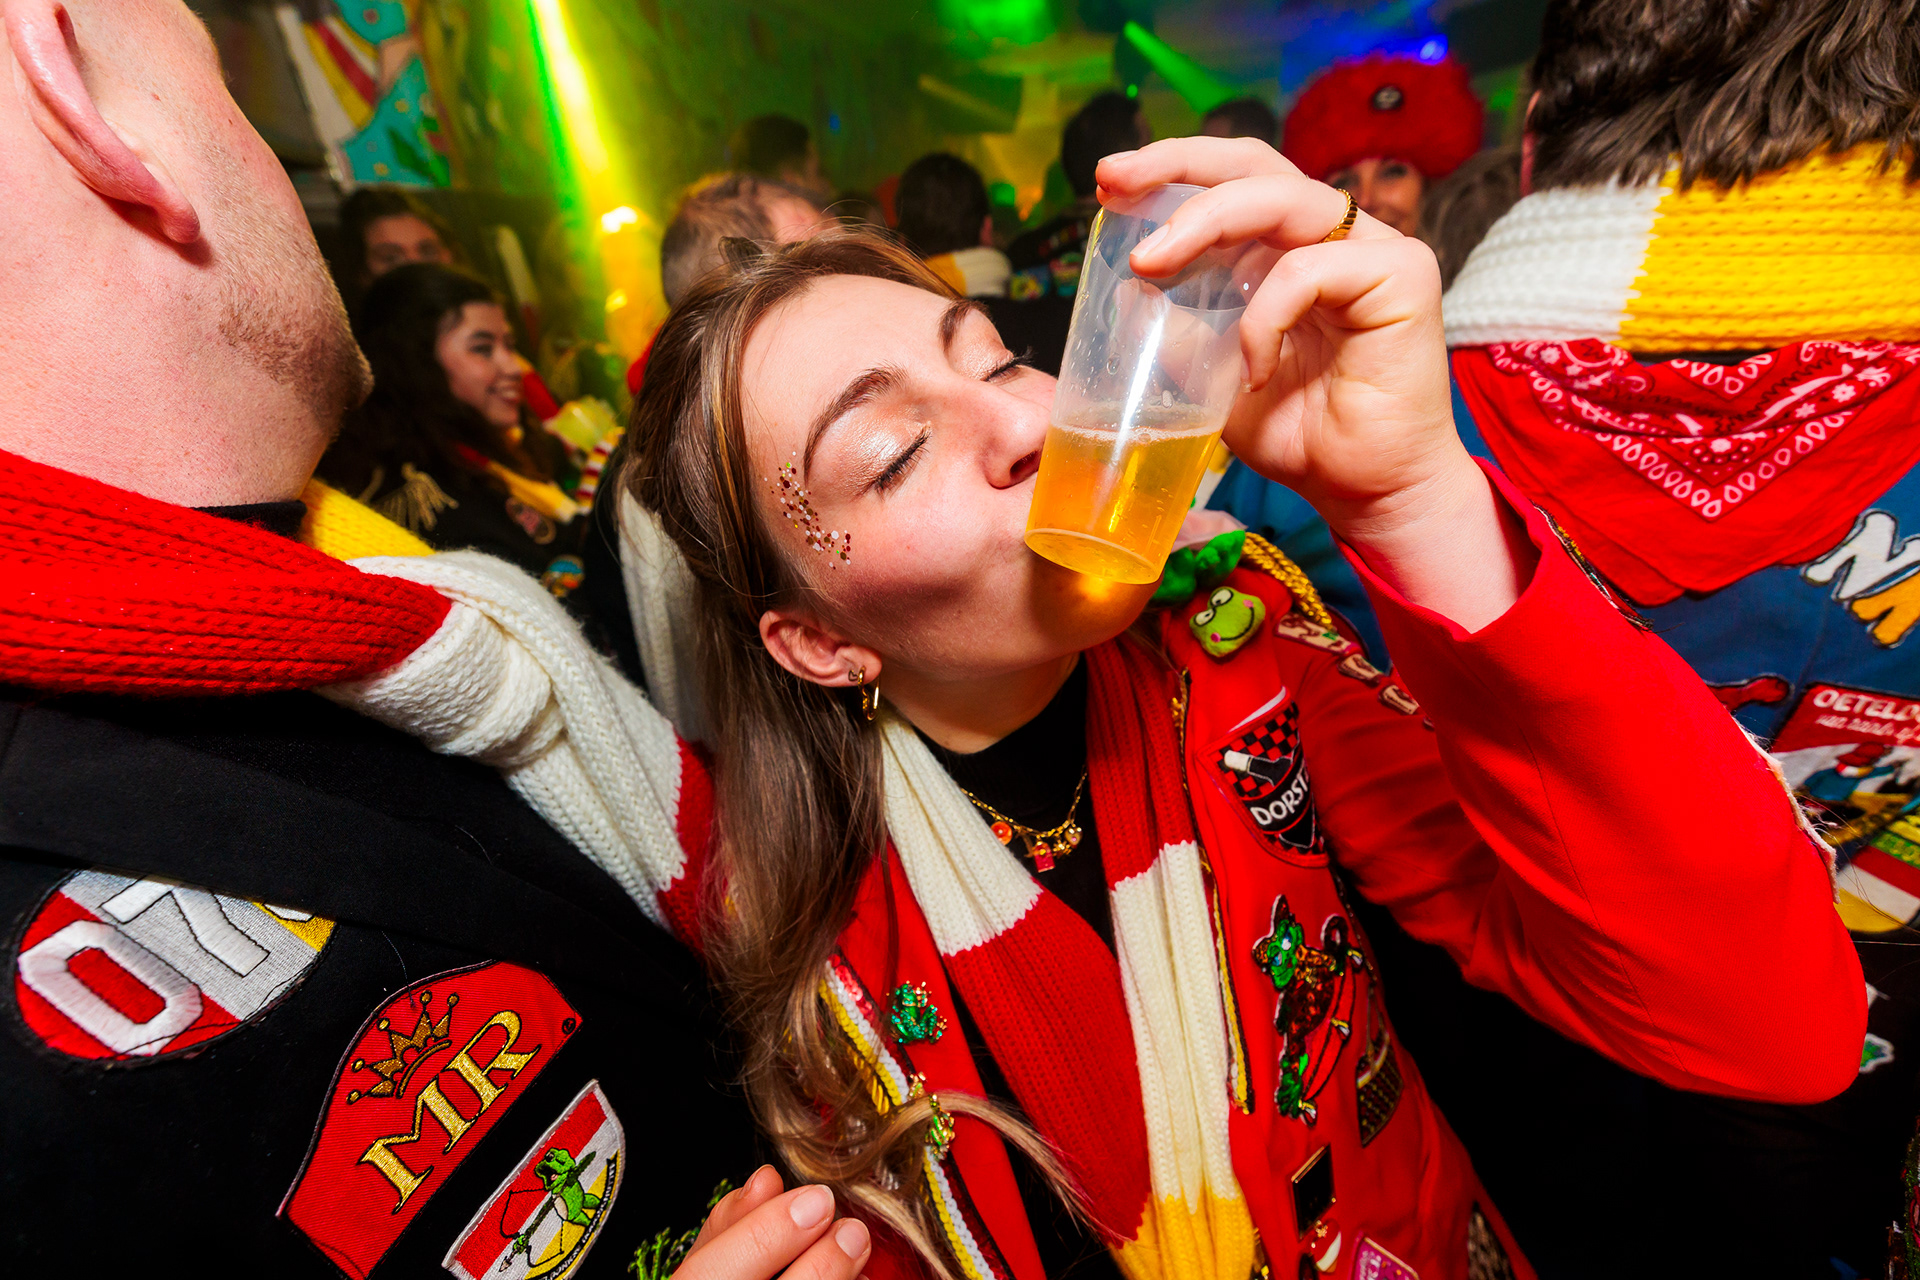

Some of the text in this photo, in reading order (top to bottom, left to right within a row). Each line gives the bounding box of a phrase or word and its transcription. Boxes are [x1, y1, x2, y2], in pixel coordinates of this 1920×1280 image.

[1813, 689, 1920, 724] OETELD
[17, 873, 316, 1057] 07
[356, 1009, 543, 1215] MR
